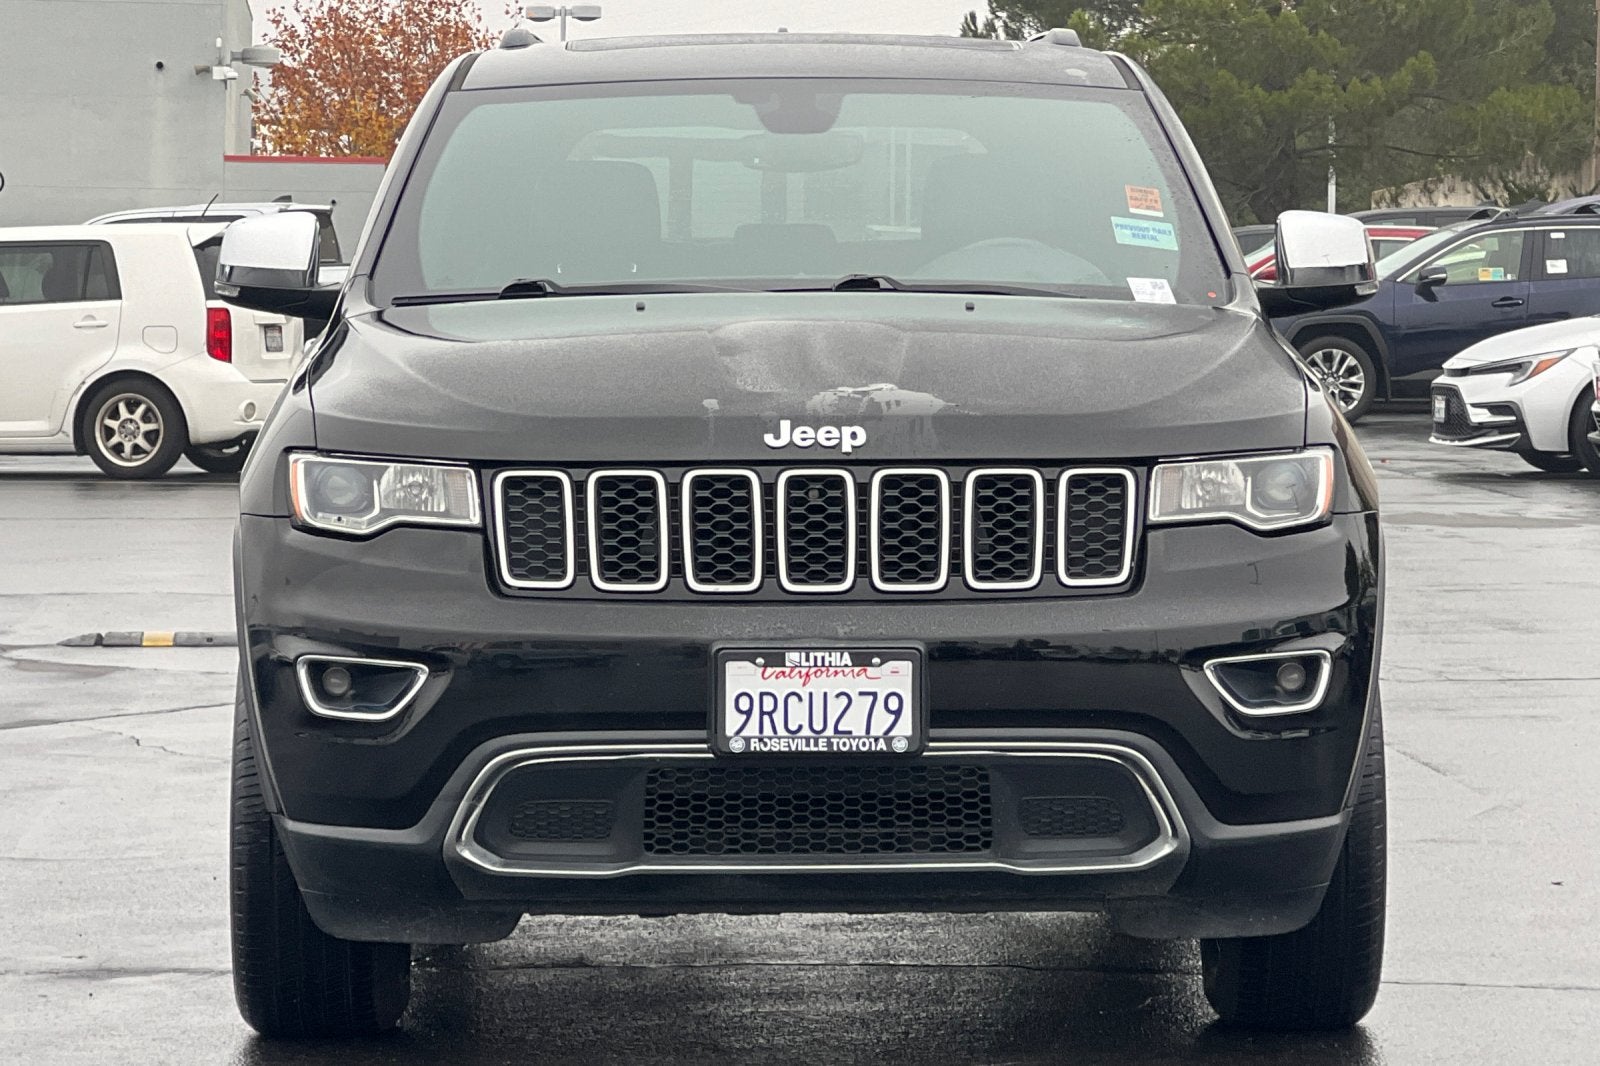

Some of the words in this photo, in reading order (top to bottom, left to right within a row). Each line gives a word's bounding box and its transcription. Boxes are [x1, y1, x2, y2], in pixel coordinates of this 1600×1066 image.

[764, 420, 866, 452] Jeep
[800, 652, 852, 667] LITHIA
[761, 666, 881, 687] California
[734, 691, 904, 736] 9RCU279
[750, 738, 828, 751] ROSEVILLE
[830, 738, 887, 751] TOYOTA
